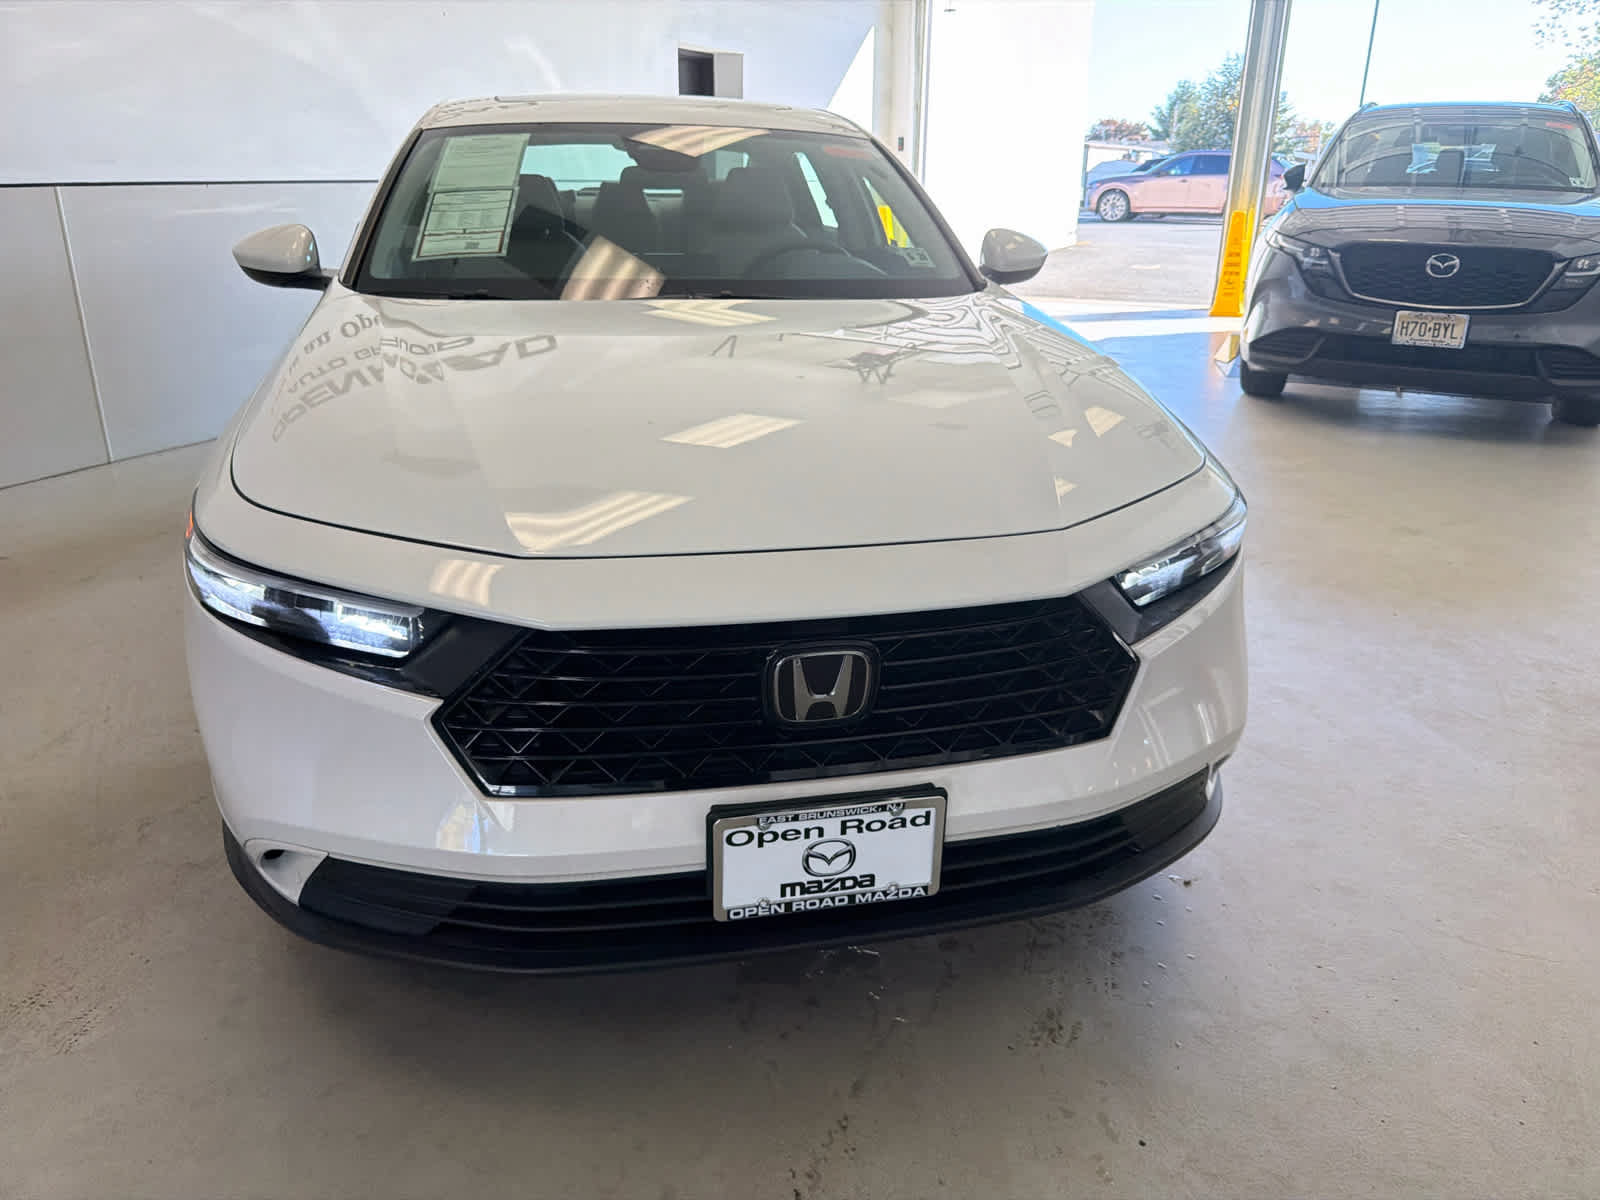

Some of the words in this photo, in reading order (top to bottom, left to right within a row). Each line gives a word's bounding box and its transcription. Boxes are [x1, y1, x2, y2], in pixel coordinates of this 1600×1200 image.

[725, 825, 825, 848] Open
[840, 811, 932, 836] Road
[758, 813, 796, 825] EAST
[780, 873, 876, 898] mazda
[729, 903, 785, 920] OPEN
[791, 895, 849, 912] ROAD
[855, 886, 927, 904] MAZDA
